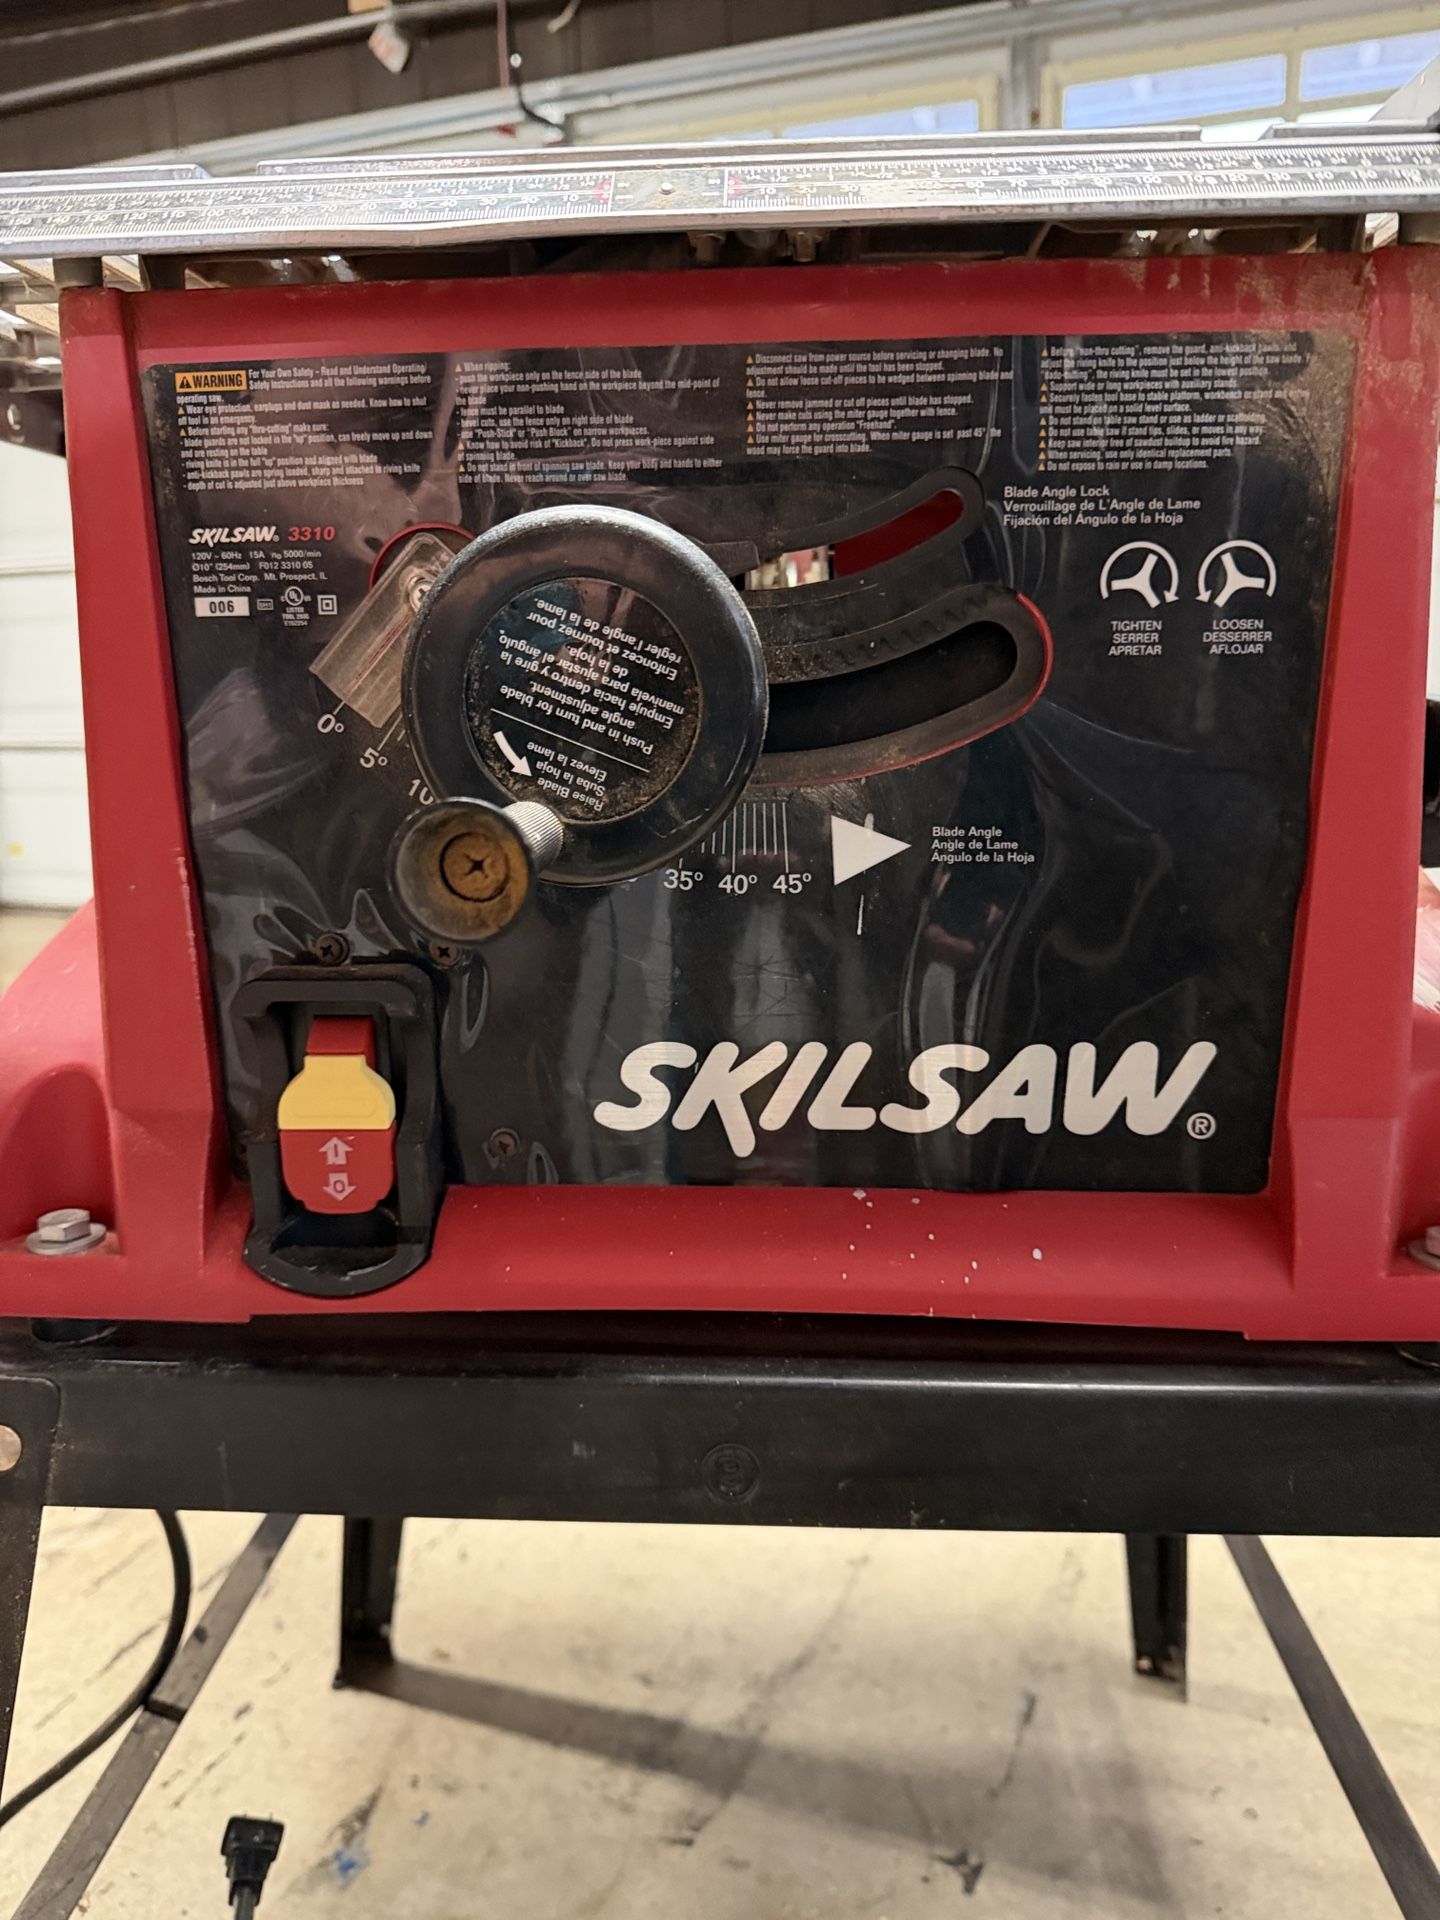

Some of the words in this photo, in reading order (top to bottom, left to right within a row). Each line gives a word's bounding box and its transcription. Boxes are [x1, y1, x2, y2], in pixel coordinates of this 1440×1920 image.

[562, 193, 579, 202] 10
[759, 187, 776, 195] 10
[192, 373, 242, 388] WARNING
[292, 367, 314, 379] Safety
[489, 371, 525, 384] workpiece
[524, 370, 541, 383] only
[541, 371, 551, 381] on
[551, 369, 563, 380] the
[1003, 485, 1039, 498] Blade
[1040, 485, 1077, 500] Angle
[1080, 484, 1110, 497] Lock
[1002, 499, 1077, 514] Verrouillage
[1078, 498, 1096, 514] de
[1098, 497, 1146, 514] L'Angle
[1148, 497, 1164, 510] de
[1167, 497, 1201, 510] Lame
[1003, 513, 1050, 528] Fijación
[1053, 513, 1073, 526] del
[1074, 511, 1119, 528] Ángulo
[1121, 511, 1138, 525] de
[1140, 511, 1152, 524] la
[1154, 511, 1184, 527] Hoja
[287, 526, 336, 542] 3310
[191, 551, 213, 561] 120V
[220, 551, 243, 560] 60Hz
[248, 550, 266, 559] 15A
[282, 549, 322, 559] 5000/min
[258, 561, 279, 570] F012
[280, 560, 302, 570] 3310
[302, 560, 314, 570] 05
[192, 574, 219, 583] Bosch
[218, 572, 237, 582] Tool
[193, 585, 217, 594] Made
[217, 585, 226, 593] in
[226, 583, 252, 593] China
[209, 600, 235, 613] 006
[534, 598, 568, 621] lame.
[526, 612, 557, 629] pour
[569, 612, 582, 627] la
[583, 618, 601, 633] de
[1110, 619, 1163, 632] TIGHTEN
[1212, 618, 1264, 630] LOOSEN
[558, 623, 605, 648] tournez
[601, 625, 644, 652] l'angle
[1112, 632, 1159, 644] SERRER
[1202, 630, 1273, 643] DESSERRER
[498, 634, 542, 660] ángulo
[605, 643, 620, 655] et
[643, 643, 682, 664] régler
[1107, 644, 1162, 656] APRETAR
[1209, 643, 1264, 655] AFLOJAR
[500, 650, 513, 666] la
[541, 652, 556, 664] el
[567, 645, 597, 667] hoja.
[514, 656, 540, 673] gire
[539, 665, 551, 677] y
[555, 658, 600, 681] ajustar
[598, 658, 611, 674] la
[611, 664, 629, 679] de
[621, 649, 678, 681] Enfoncez
[550, 671, 592, 696] dentro
[601, 675, 631, 693] para
[499, 684, 534, 708] blade
[529, 680, 600, 715] adjustment.
[592, 688, 627, 711] hacia
[630, 687, 685, 715] manivela
[534, 699, 554, 716] for
[555, 707, 581, 726] turn
[600, 710, 636, 730] angle
[628, 702, 674, 730] Empuje
[580, 718, 607, 733] and
[607, 728, 621, 742] in
[526, 741, 556, 762] lame
[622, 733, 654, 756] Push
[556, 753, 569, 767] la
[535, 760, 562, 780] hoja
[562, 771, 575, 785] la
[569, 758, 608, 782] Élevez
[536, 777, 571, 799] Blade
[575, 776, 606, 799] Suba
[572, 791, 605, 812] Raise
[932, 825, 966, 837] Blade
[967, 825, 1003, 840] Angle
[931, 838, 966, 852] Angle
[968, 838, 984, 850] de
[984, 837, 1019, 850] Lame
[930, 850, 973, 865] Ángulo
[974, 851, 990, 863] de
[993, 851, 1005, 863] la
[1006, 851, 1035, 865] Hoja
